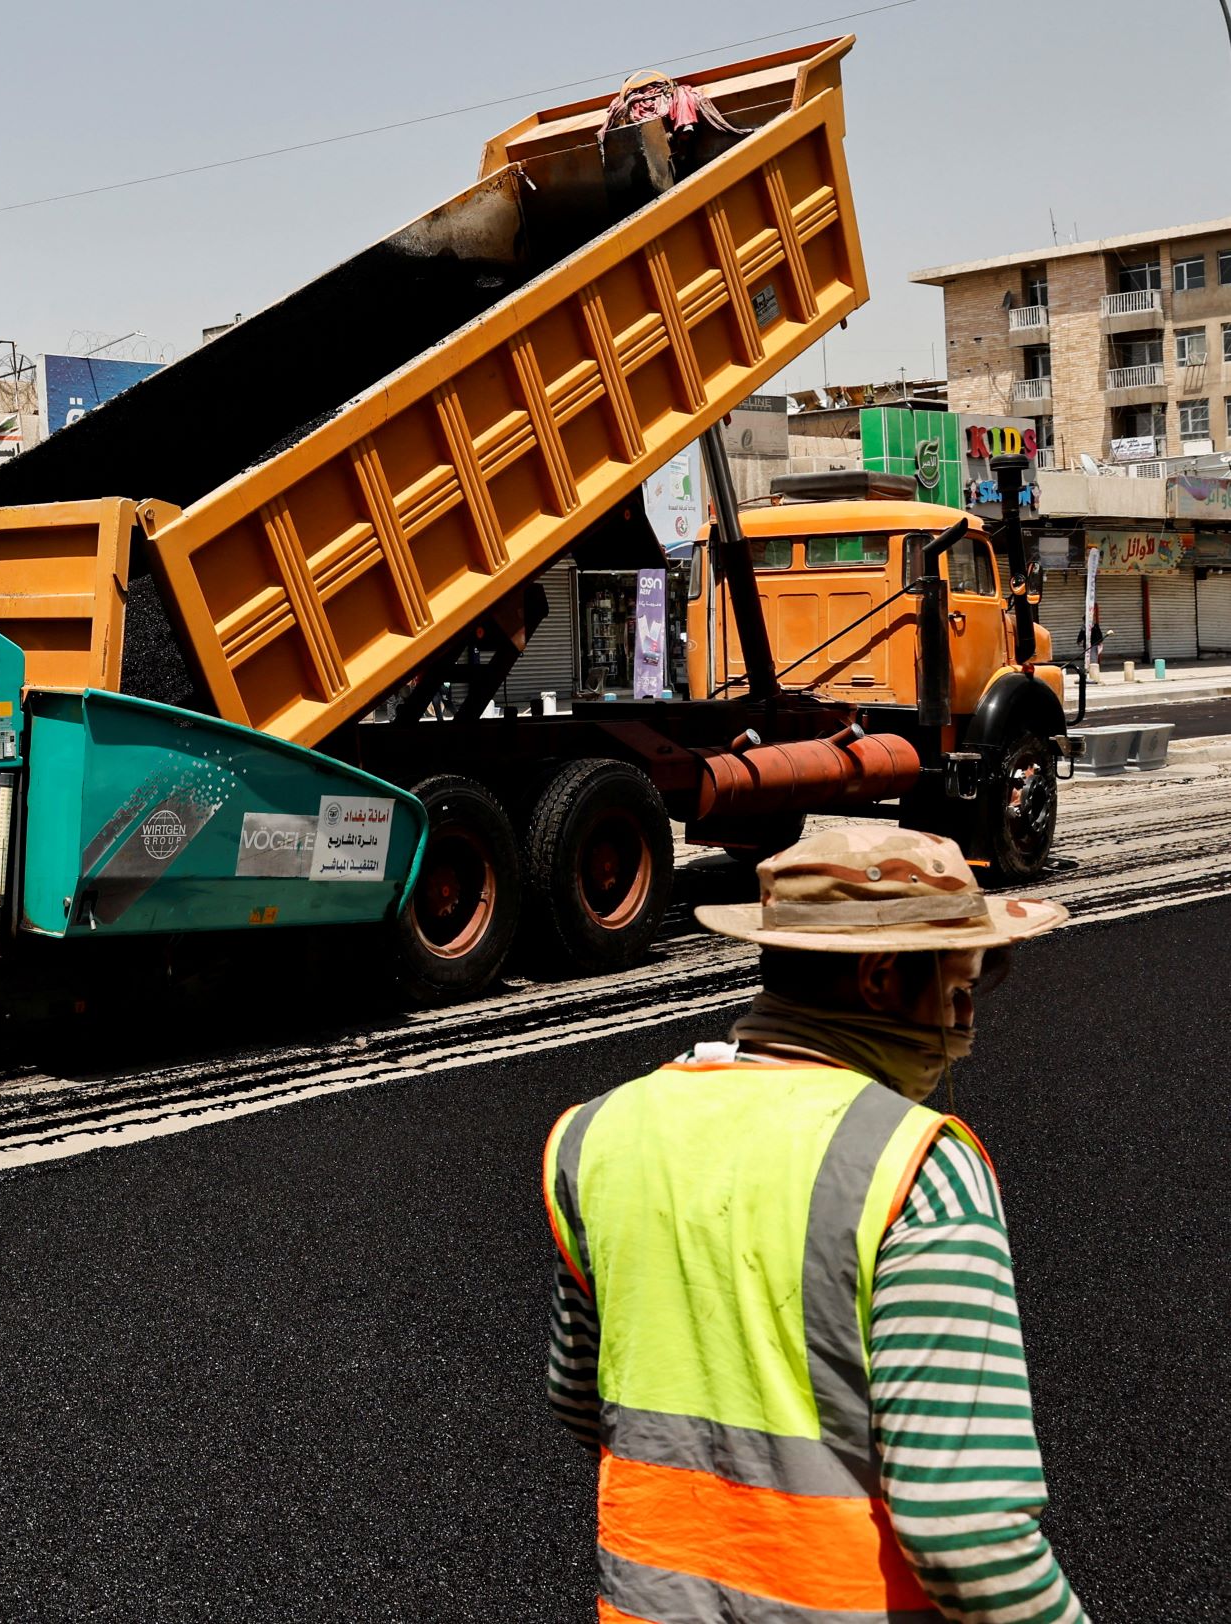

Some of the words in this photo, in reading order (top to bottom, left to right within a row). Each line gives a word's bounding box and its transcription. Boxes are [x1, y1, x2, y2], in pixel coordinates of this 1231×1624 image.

[968, 425, 1037, 459] KIDS
[343, 809, 366, 827] بغداد
[367, 808, 390, 823] أمانة
[142, 824, 186, 835] WIRTGEN
[144, 837, 183, 846] GROUP
[243, 826, 316, 851] VÖGELE
[327, 833, 357, 848] المشاريع
[319, 857, 349, 874] المباشر
